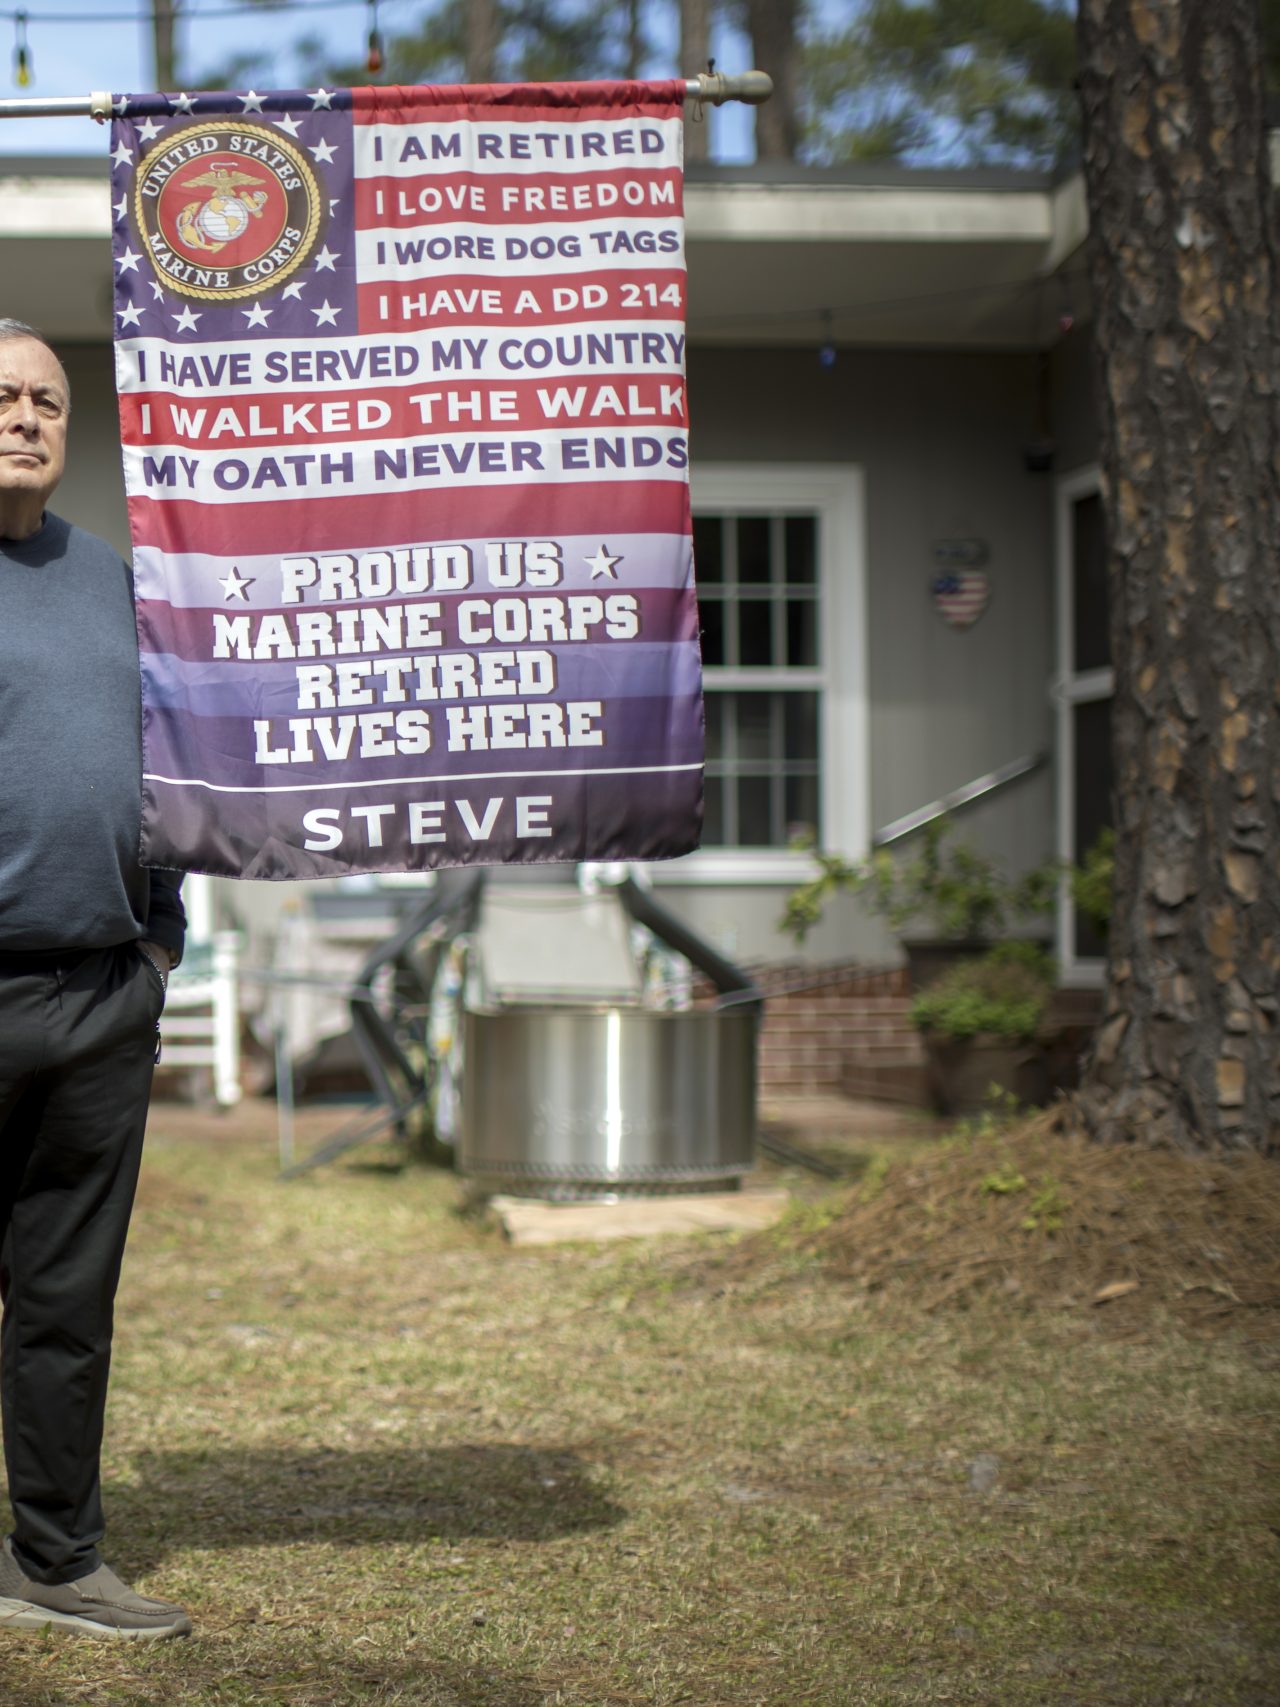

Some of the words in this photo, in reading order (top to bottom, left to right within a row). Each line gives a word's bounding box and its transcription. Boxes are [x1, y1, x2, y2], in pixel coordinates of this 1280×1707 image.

[141, 135, 219, 197] UNITED
[229, 135, 302, 191] STATES
[374, 136, 383, 162] I
[399, 132, 462, 162] AM
[477, 129, 665, 160] RETIRED
[376, 190, 384, 215] I
[399, 185, 487, 216] LOVE
[502, 180, 676, 212] FREEDOM
[148, 231, 230, 288] MARINE
[242, 226, 302, 282] CORPS
[377, 241, 386, 265] I
[395, 236, 496, 265] WORE
[505, 236, 581, 261] DOG
[590, 230, 680, 254] TAGS
[379, 295, 389, 320] I
[402, 288, 504, 320] HAVE
[514, 290, 542, 314] A
[552, 284, 609, 312] DD
[620, 283, 682, 308] 214
[137, 350, 146, 382] I
[160, 350, 252, 388] HAVE
[264, 345, 420, 384] SERVED
[432, 338, 488, 372] MY
[498, 332, 686, 370] COUNTRY
[141, 403, 151, 435] I
[169, 399, 393, 439] WALKED
[409, 390, 520, 425] THE
[536, 384, 685, 419] WALK
[143, 455, 200, 488] MY
[213, 452, 354, 491] OATH
[374, 441, 546, 481] NEVER
[561, 436, 688, 470] ENDS
[280, 544, 474, 604] PROUD
[484, 541, 563, 589] US
[213, 601, 447, 661] MARINE
[456, 594, 641, 646] CORPS
[295, 649, 558, 711] RETIRED
[253, 709, 433, 766] LIVES
[446, 701, 606, 752] HERE
[303, 795, 554, 852] STEVE
